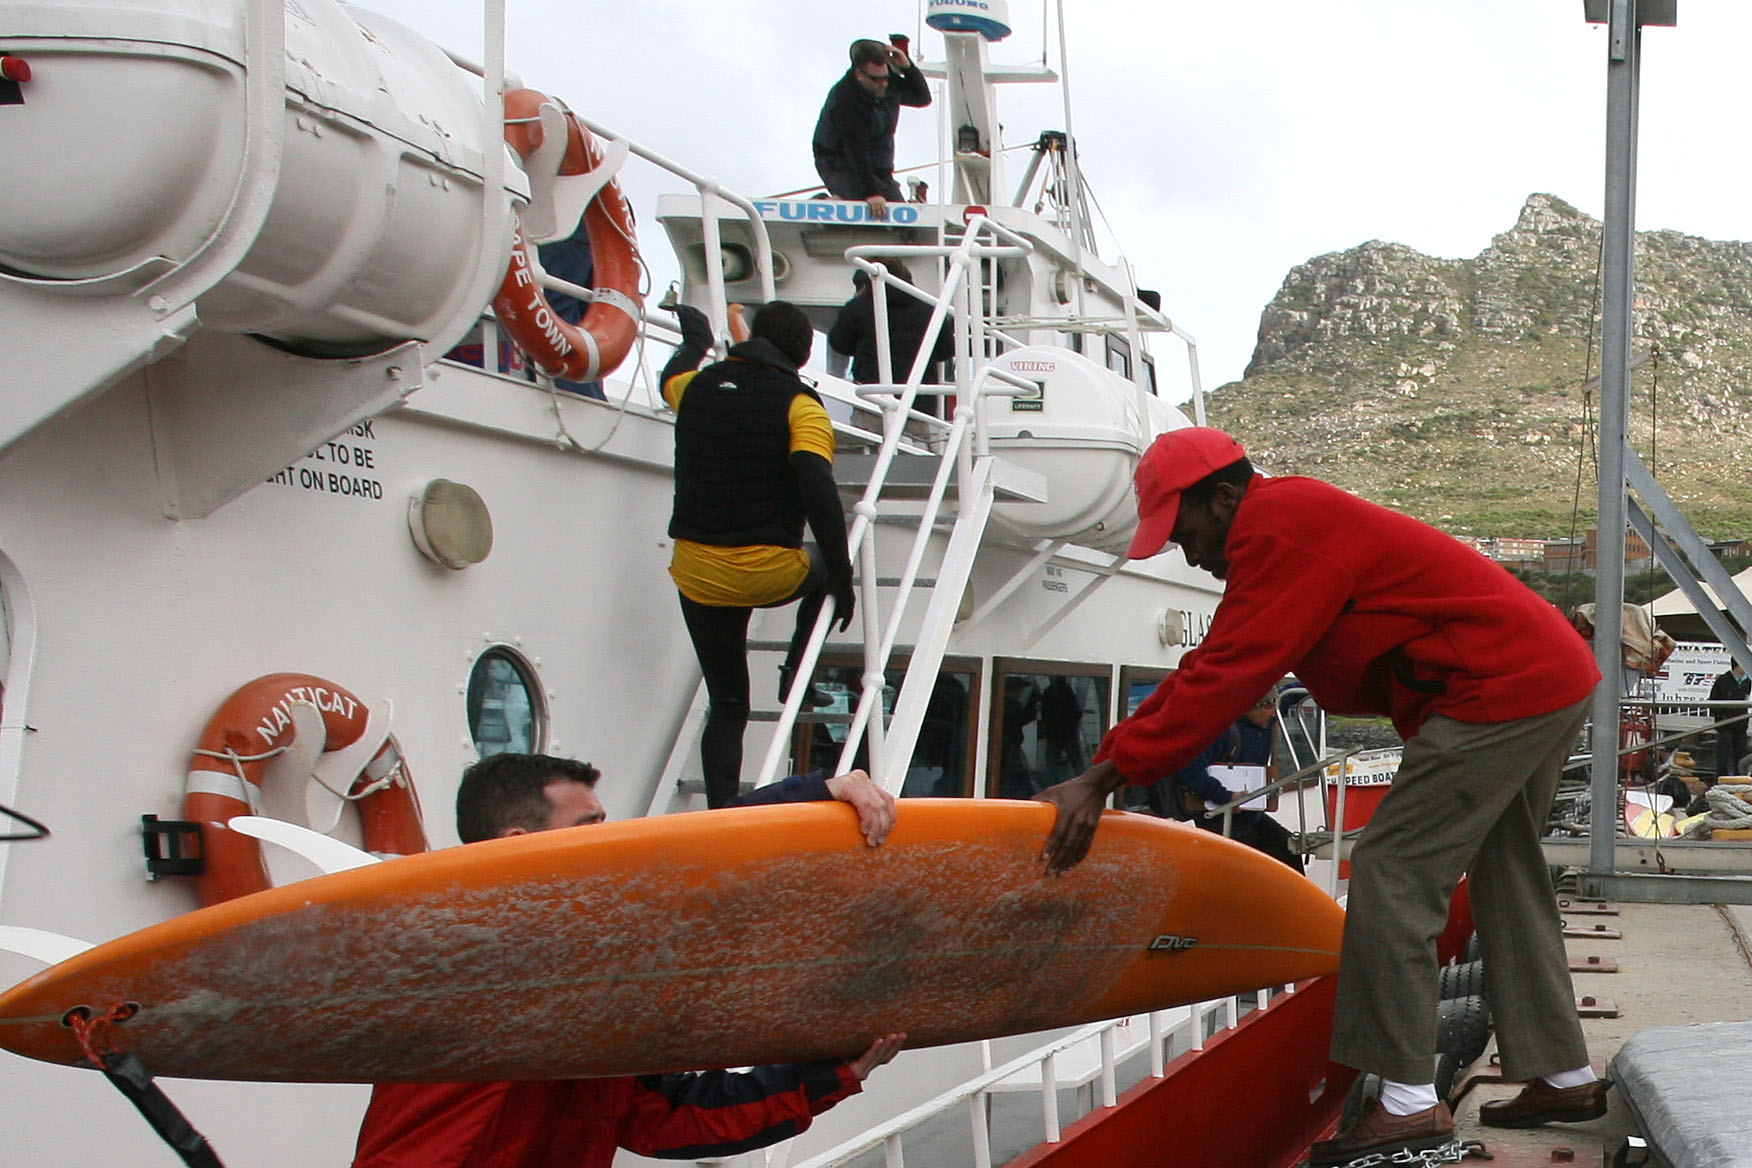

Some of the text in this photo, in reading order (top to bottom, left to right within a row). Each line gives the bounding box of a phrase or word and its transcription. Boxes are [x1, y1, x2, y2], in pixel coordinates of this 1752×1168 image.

[527, 291, 573, 357] TOWN
[1010, 361, 1056, 372] VIKING
[328, 443, 349, 464] TO
[354, 447, 375, 469] BE
[300, 468, 324, 491] ON
[328, 473, 383, 500] BOARD
